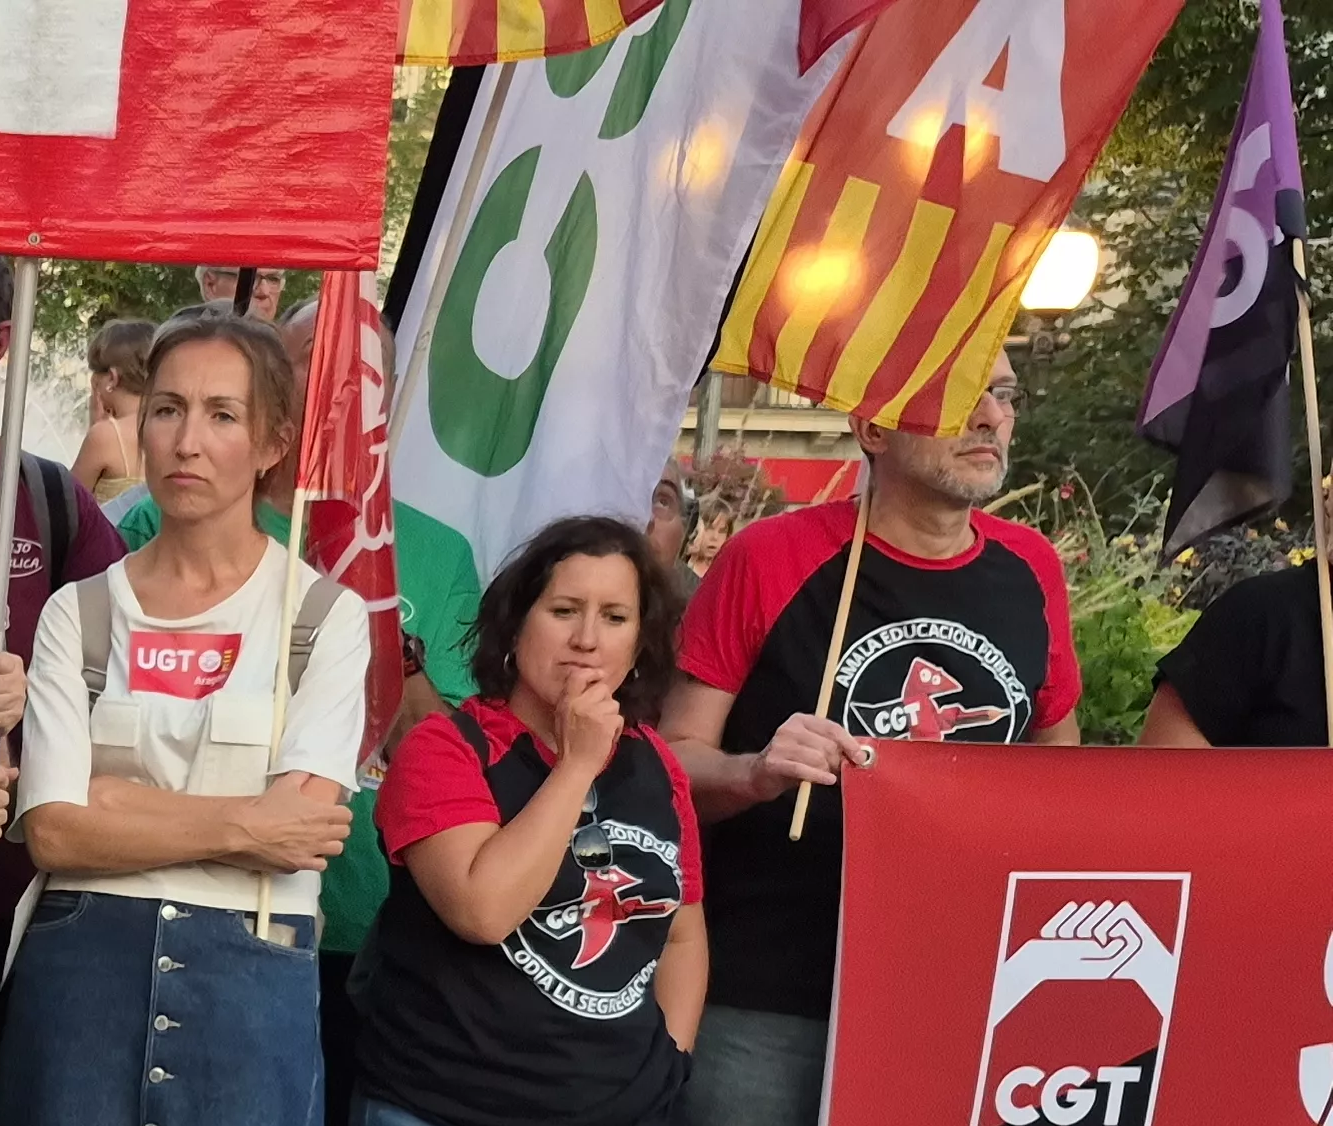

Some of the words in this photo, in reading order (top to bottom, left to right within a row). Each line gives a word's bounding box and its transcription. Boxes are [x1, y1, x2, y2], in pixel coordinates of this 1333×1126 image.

[137, 647, 195, 672] UGT
[875, 702, 920, 734] CGT
[546, 898, 601, 930] CGT
[514, 949, 551, 990] ODIA
[553, 981, 575, 1008] LA
[995, 1066, 1142, 1126] CGT
